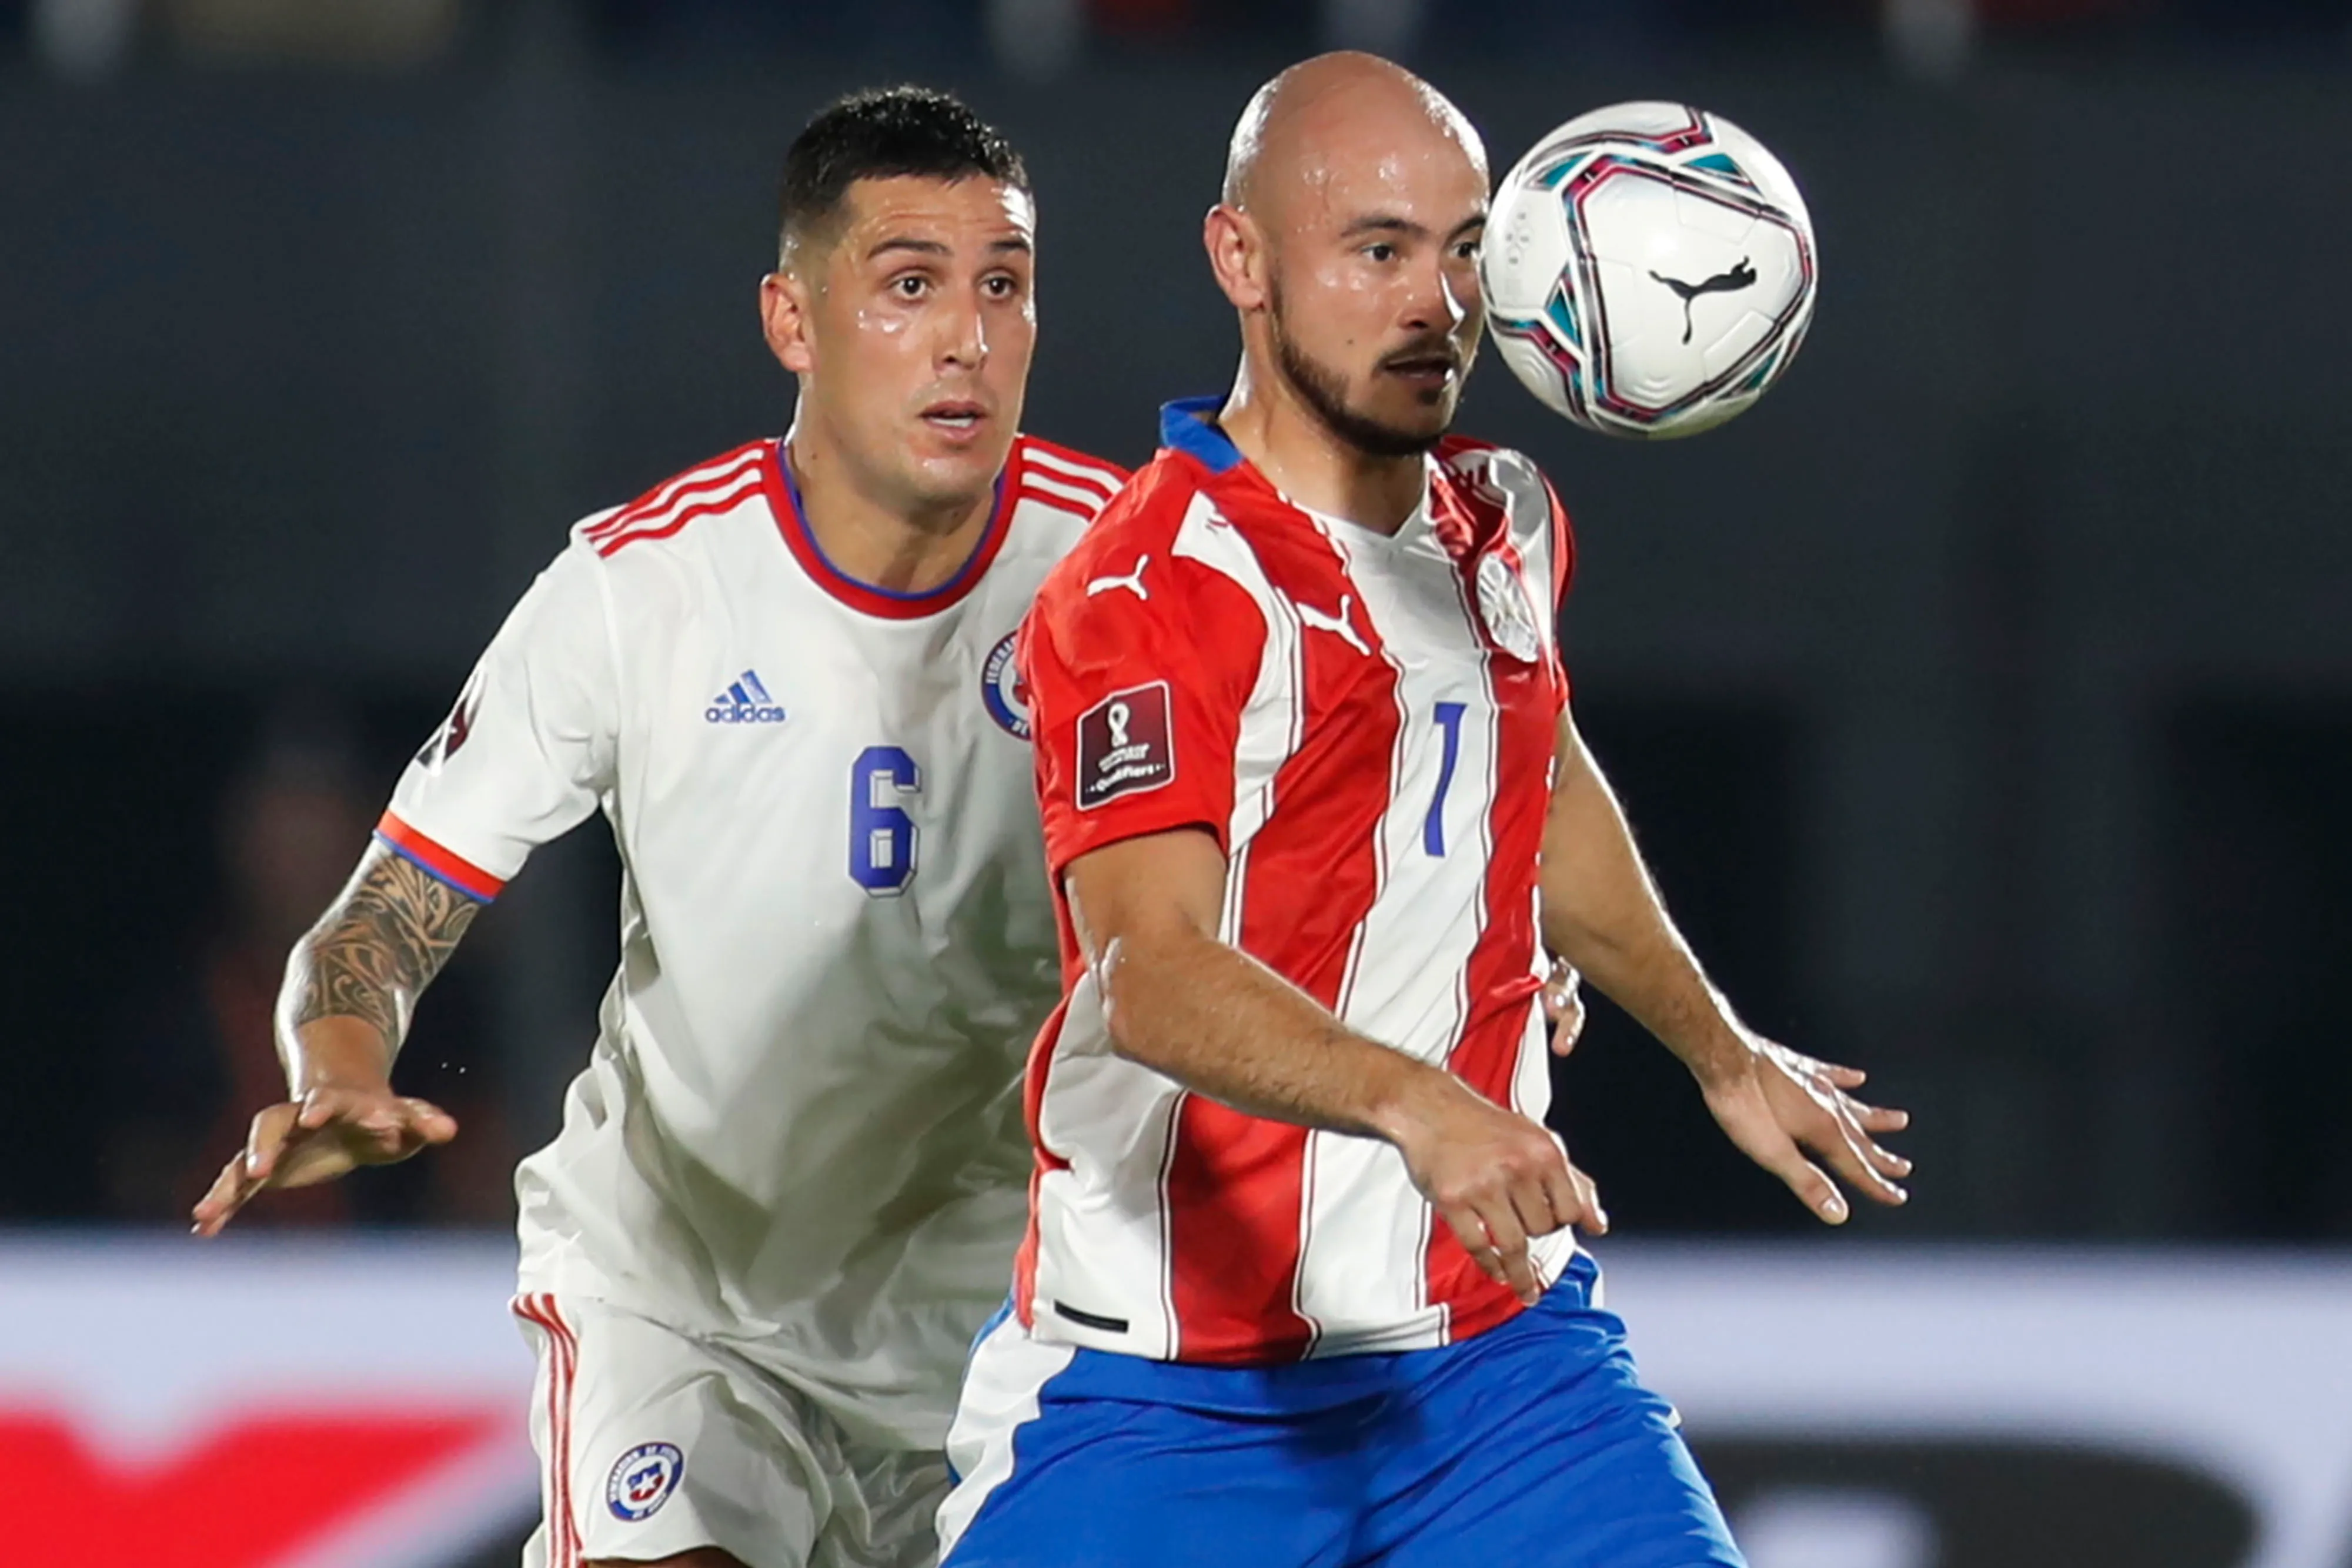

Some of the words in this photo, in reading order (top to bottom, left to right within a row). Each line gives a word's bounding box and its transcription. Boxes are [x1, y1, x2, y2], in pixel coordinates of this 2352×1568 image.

[705, 704, 786, 723] adidas
[1424, 701, 1468, 858] 7
[849, 745, 921, 898] 6
